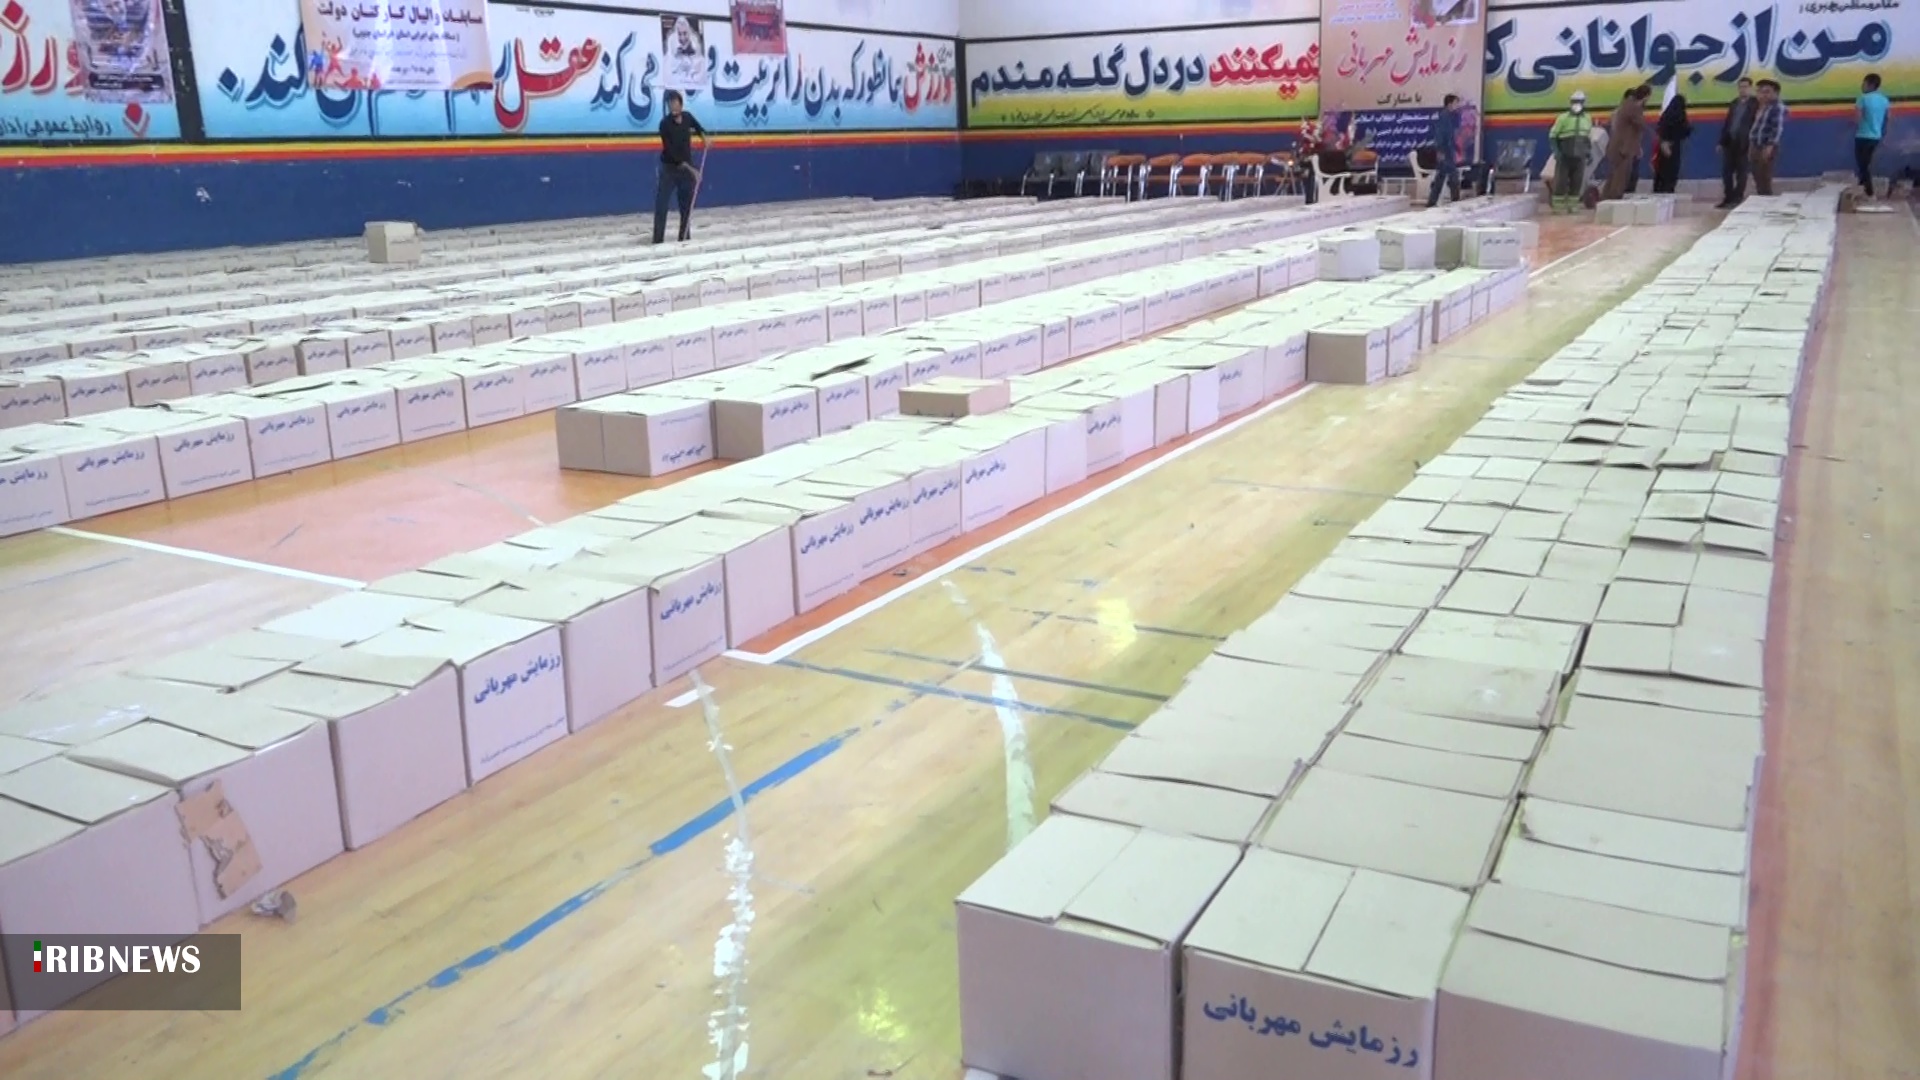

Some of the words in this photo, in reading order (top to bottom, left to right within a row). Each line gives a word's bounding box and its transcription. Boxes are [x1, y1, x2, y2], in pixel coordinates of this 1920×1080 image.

[317, 3, 347, 20] دولت
[1337, 30, 1393, 83] مهربانی
[1390, 27, 1467, 84] رزمایش
[1508, 12, 1725, 93] جوانانی
[1715, 4, 1774, 83] از
[1775, 20, 1889, 77] من
[590, 32, 635, 105] کند
[904, 42, 953, 113] ورزش
[1055, 43, 1125, 89] گله
[494, 36, 599, 130] عقل
[804, 66, 842, 119] بدن
[970, 60, 1054, 107] مندم
[1377, 93, 1412, 107] مشارکت
[1415, 92, 1422, 102] با
[25, 118, 69, 137] عمومی
[71, 115, 112, 137] روابط
[259, 420, 285, 434] مهربانی
[289, 416, 314, 429] رزمایش
[174, 437, 204, 452] مهربانی
[206, 430, 235, 446] رزمایش
[76, 455, 109, 472] مهربانی
[112, 449, 145, 465] رزمایش
[10, 468, 48, 485] رزمایش
[801, 534, 828, 555] مهربانی
[829, 521, 854, 544] رزمایش
[696, 580, 722, 606] رزمایش
[660, 595, 694, 620] مهربانی
[521, 652, 561, 684] رزمایش
[473, 671, 518, 705] مهربانی
[1203, 993, 1301, 1037] مهربانی
[1309, 1020, 1419, 1068] رزمایش
